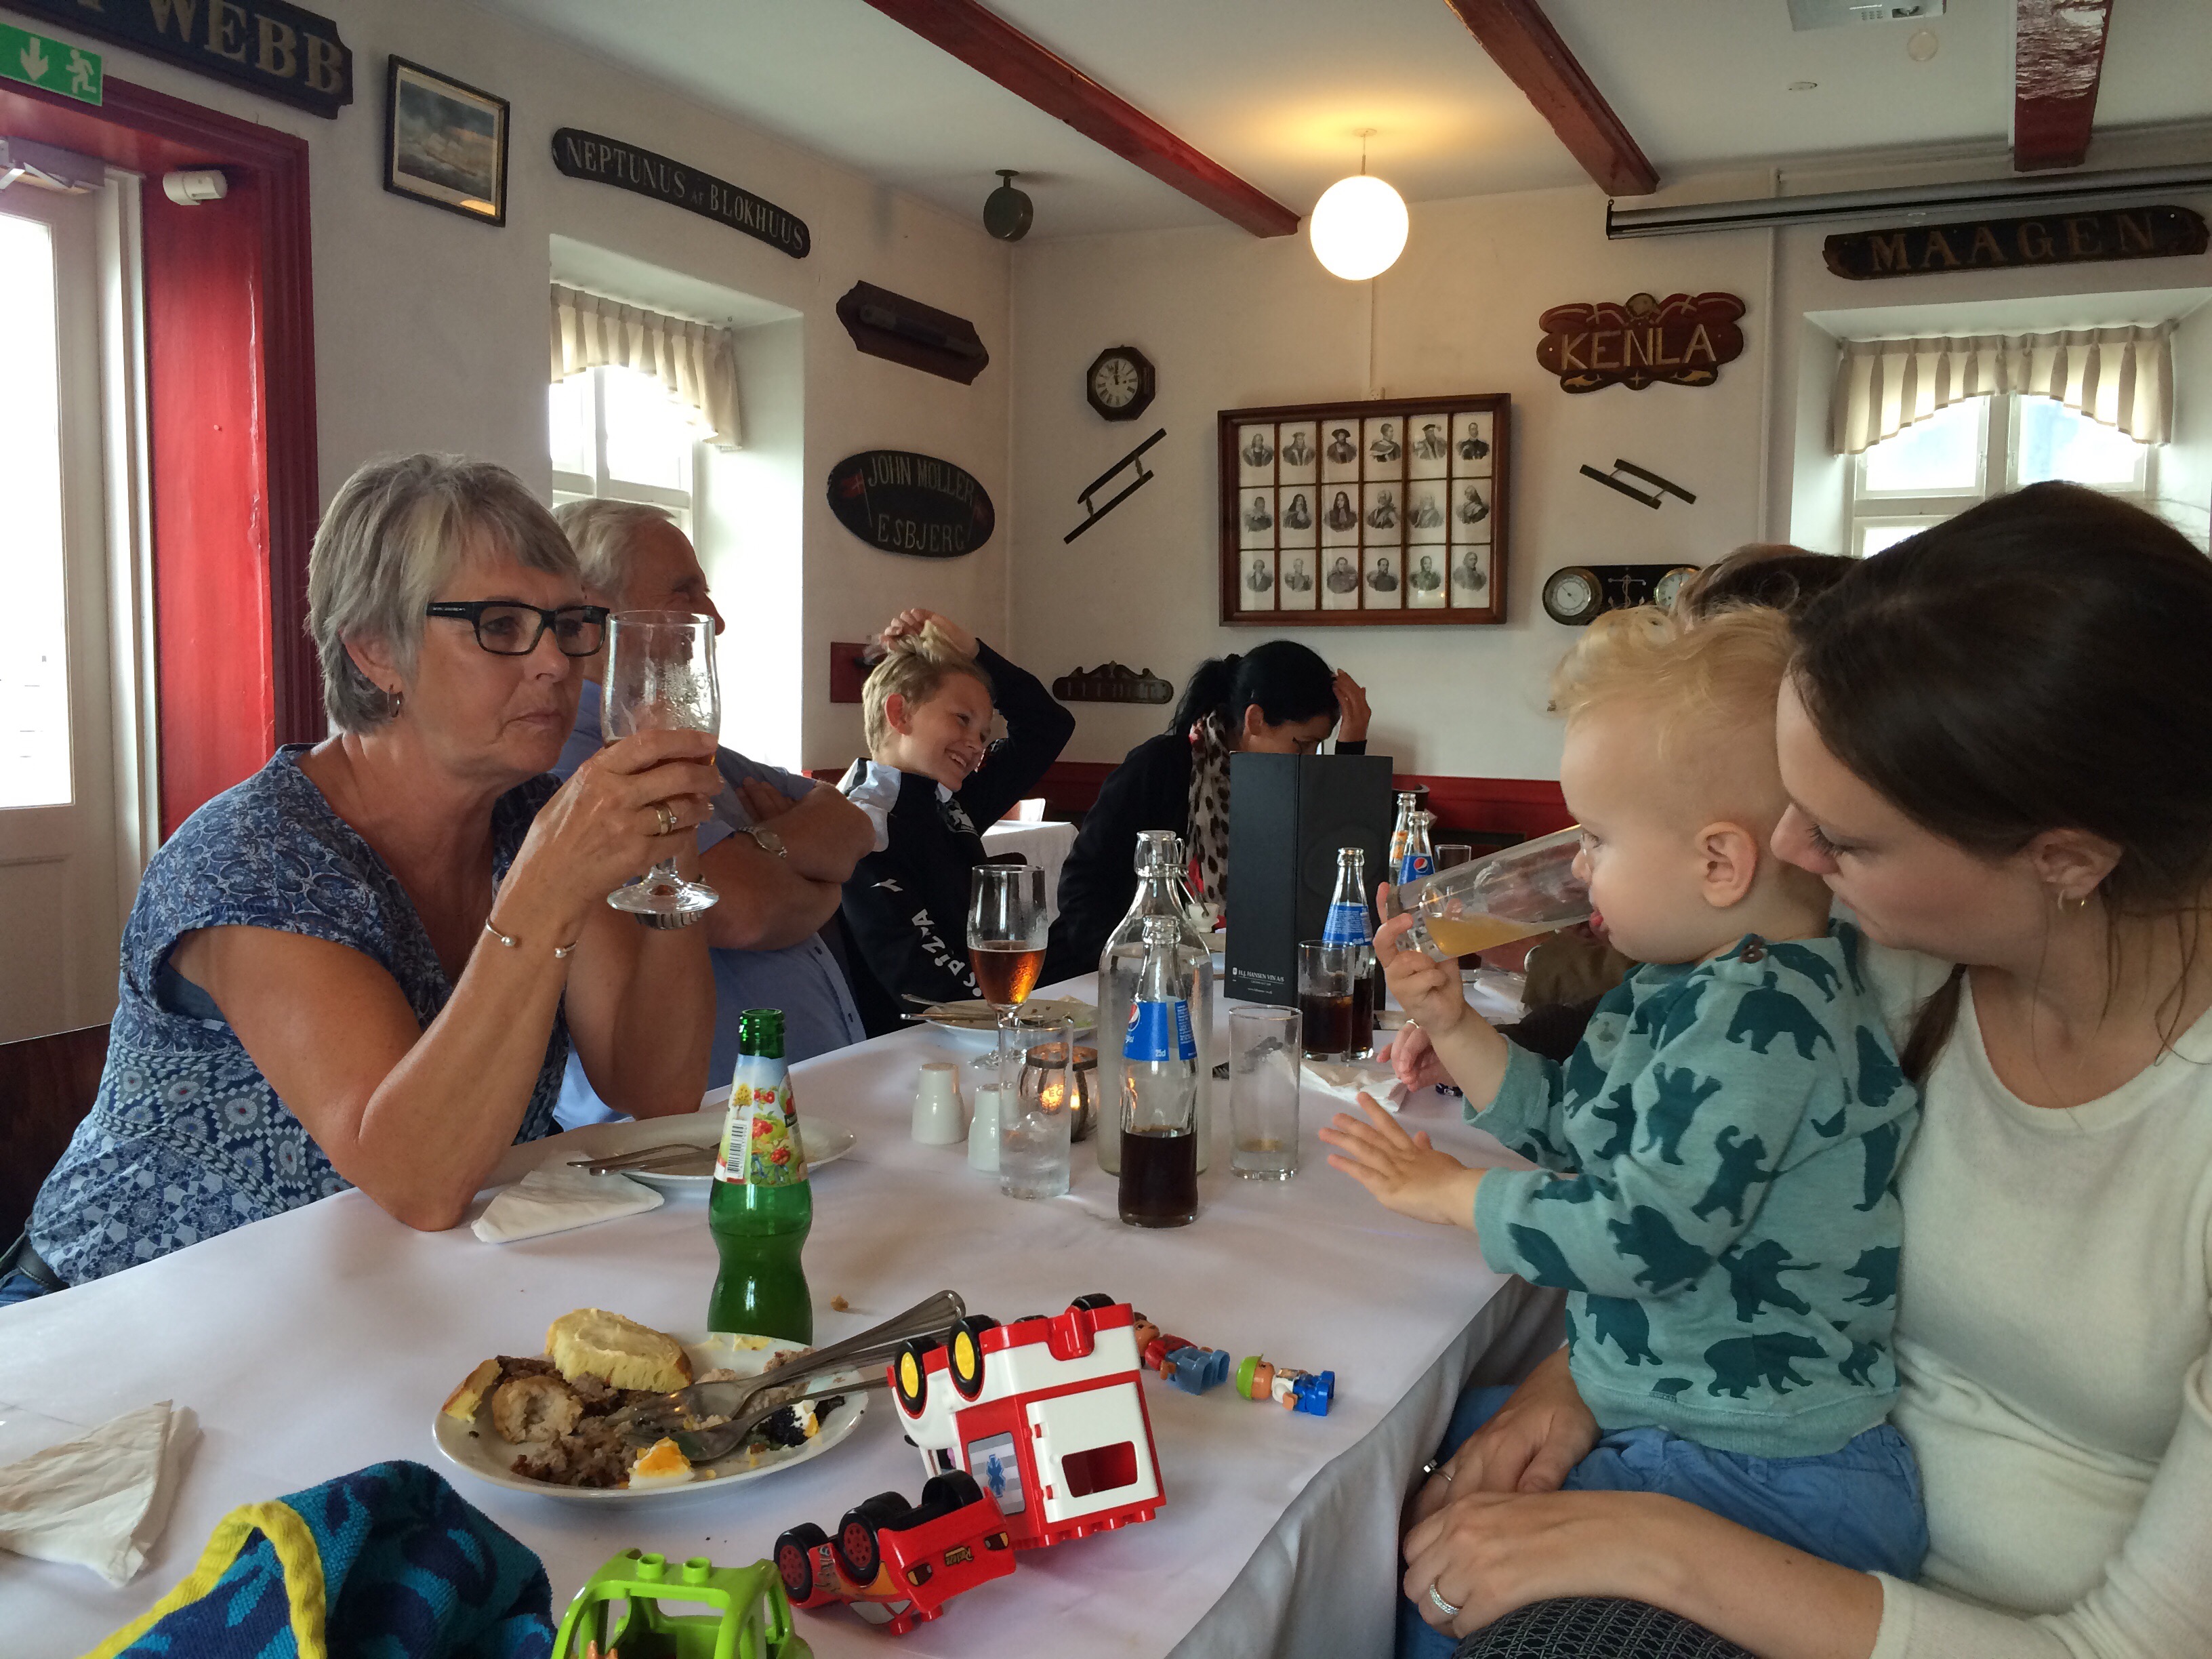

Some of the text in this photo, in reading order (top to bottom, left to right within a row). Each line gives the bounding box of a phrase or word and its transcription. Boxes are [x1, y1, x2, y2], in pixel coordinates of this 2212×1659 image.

[148, 0, 344, 95] WEBB
[566, 136, 686, 199] NEPTUNUS
[710, 184, 804, 251] BLOKHUUS
[1868, 212, 2155, 271] MAAGEN
[1561, 323, 1717, 371] KENLA
[867, 455, 912, 488] JOHN
[877, 513, 965, 553] ESBJERG
